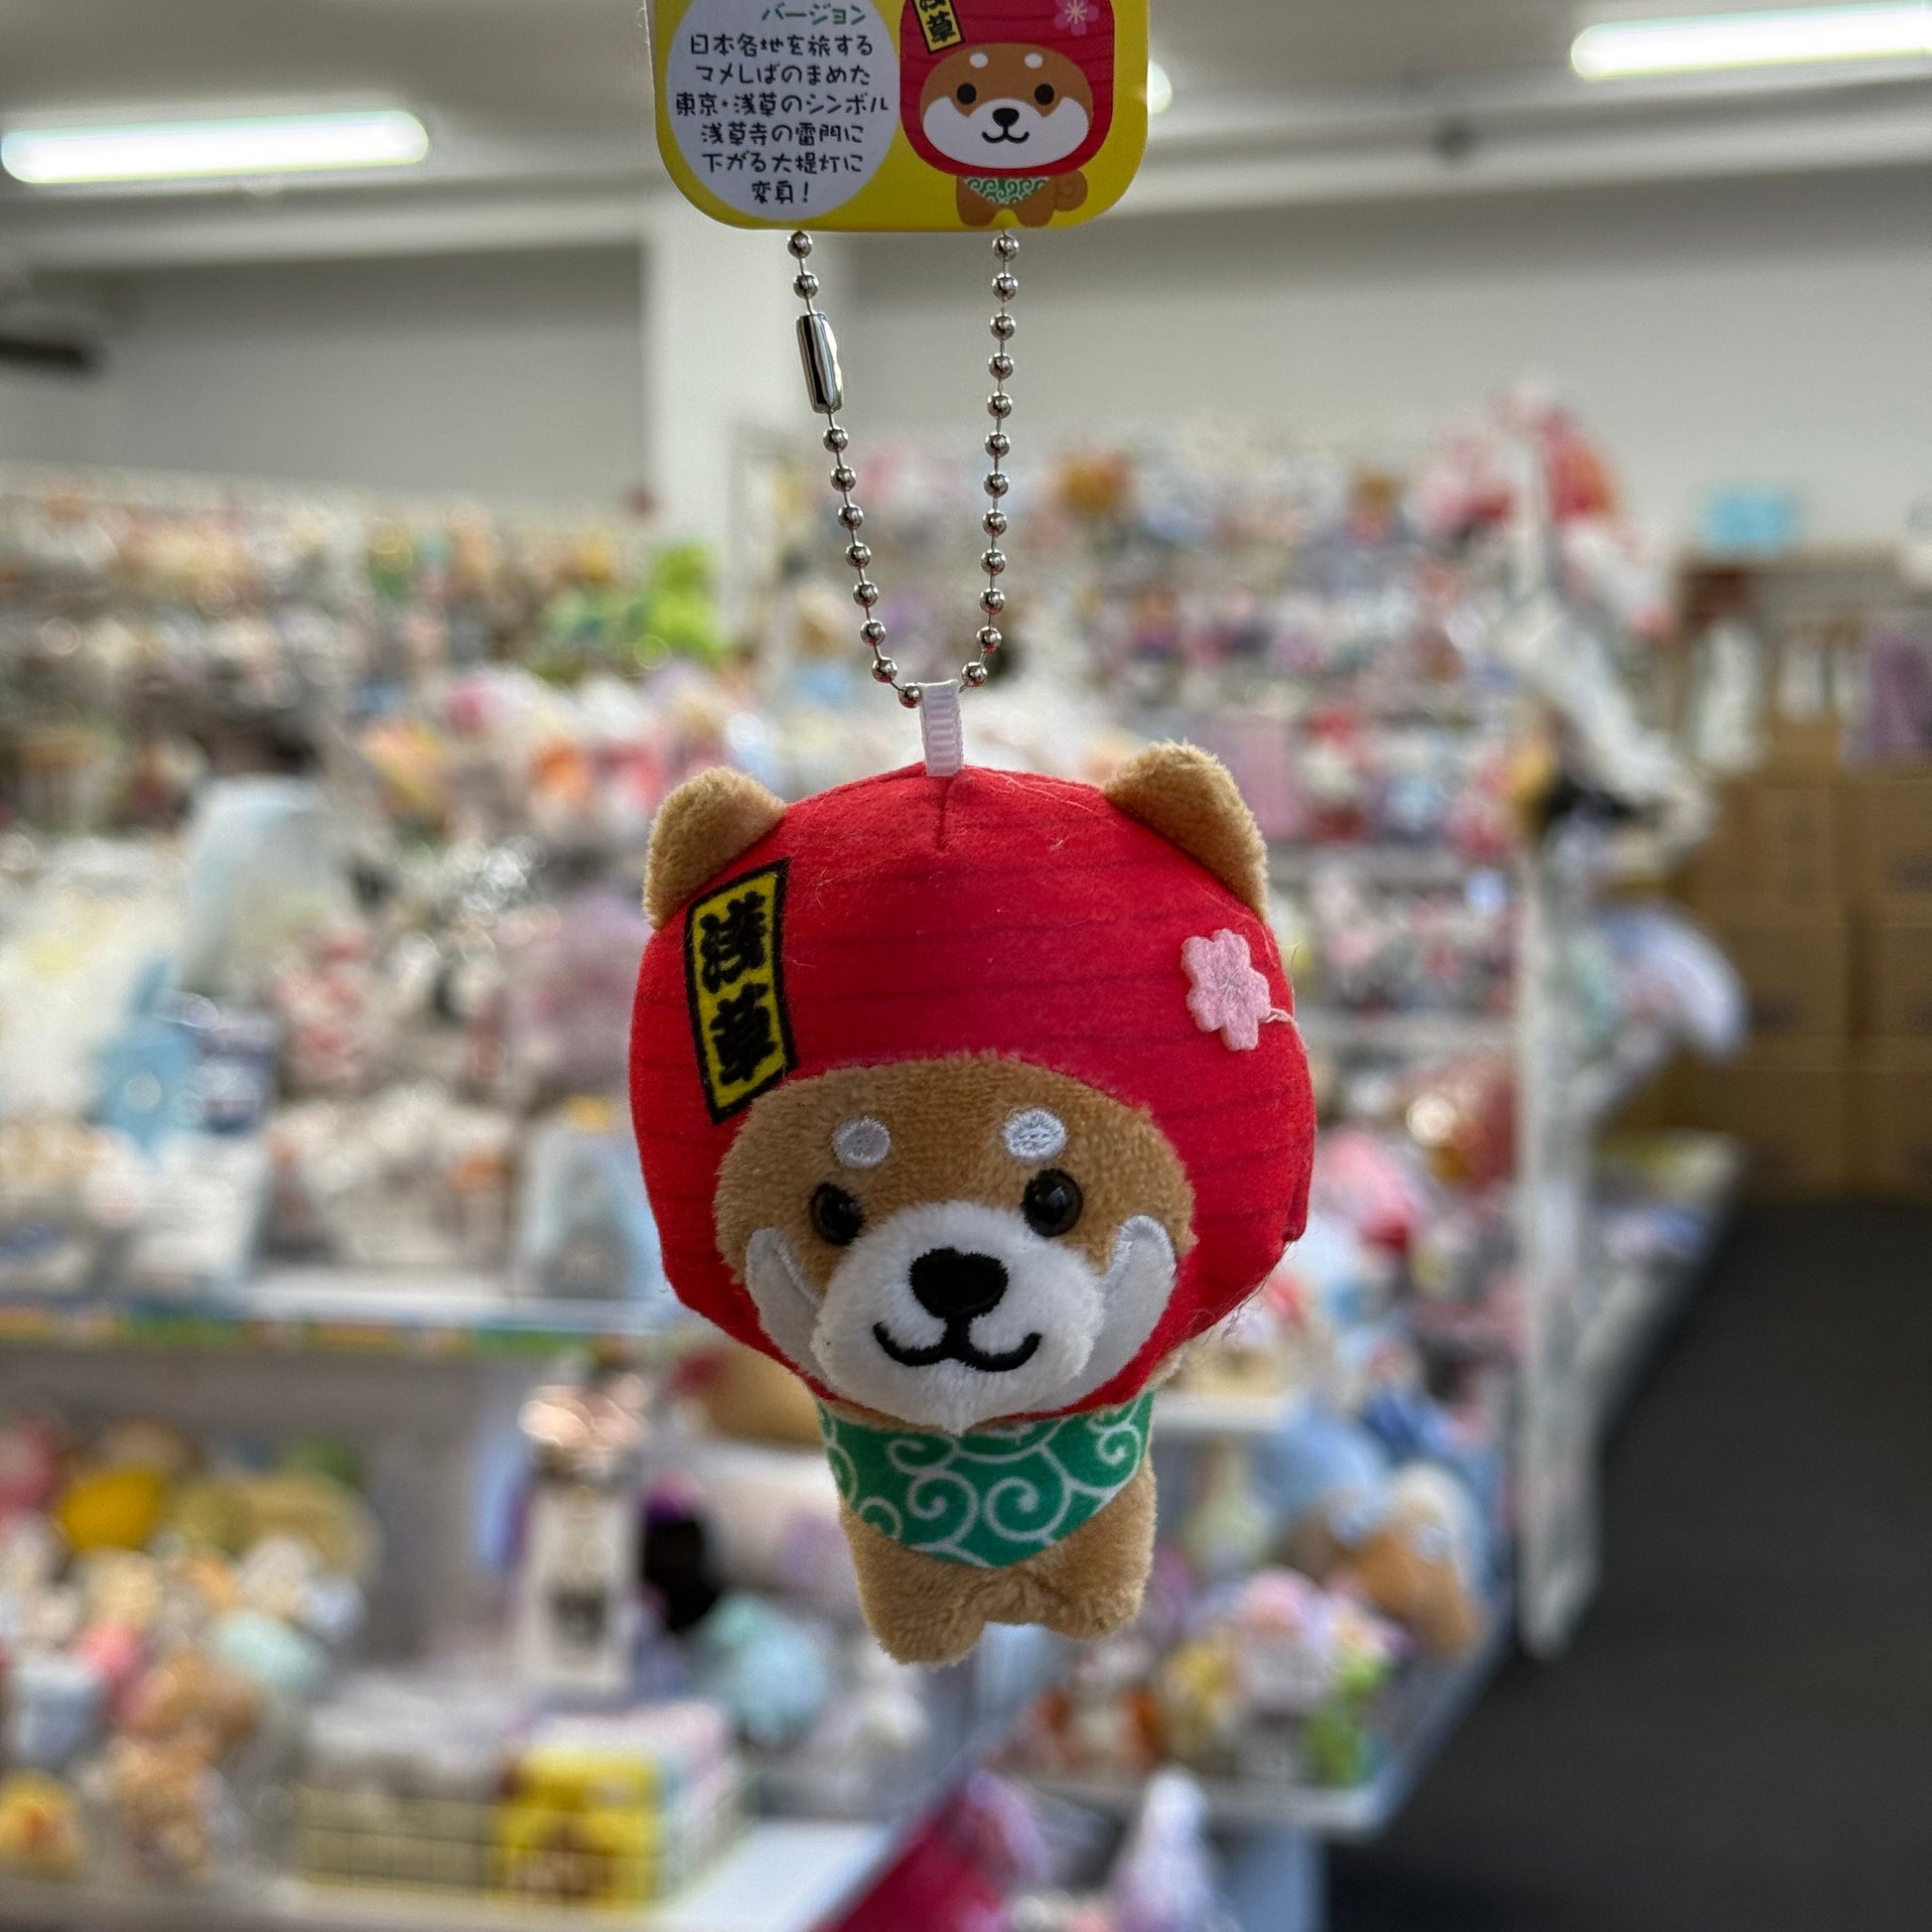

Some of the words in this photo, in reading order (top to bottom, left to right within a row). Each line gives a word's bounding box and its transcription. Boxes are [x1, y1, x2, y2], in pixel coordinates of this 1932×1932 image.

[761, 2, 867, 26] バージョン
[690, 33, 874, 58] 日本各地を旅する
[695, 63, 871, 85] マメしばのまめた
[676, 91, 889, 117] 東京・浅草のシンボル
[701, 122, 865, 147] 浅草寺の雷門に
[703, 151, 865, 175] 下がる大提灯に
